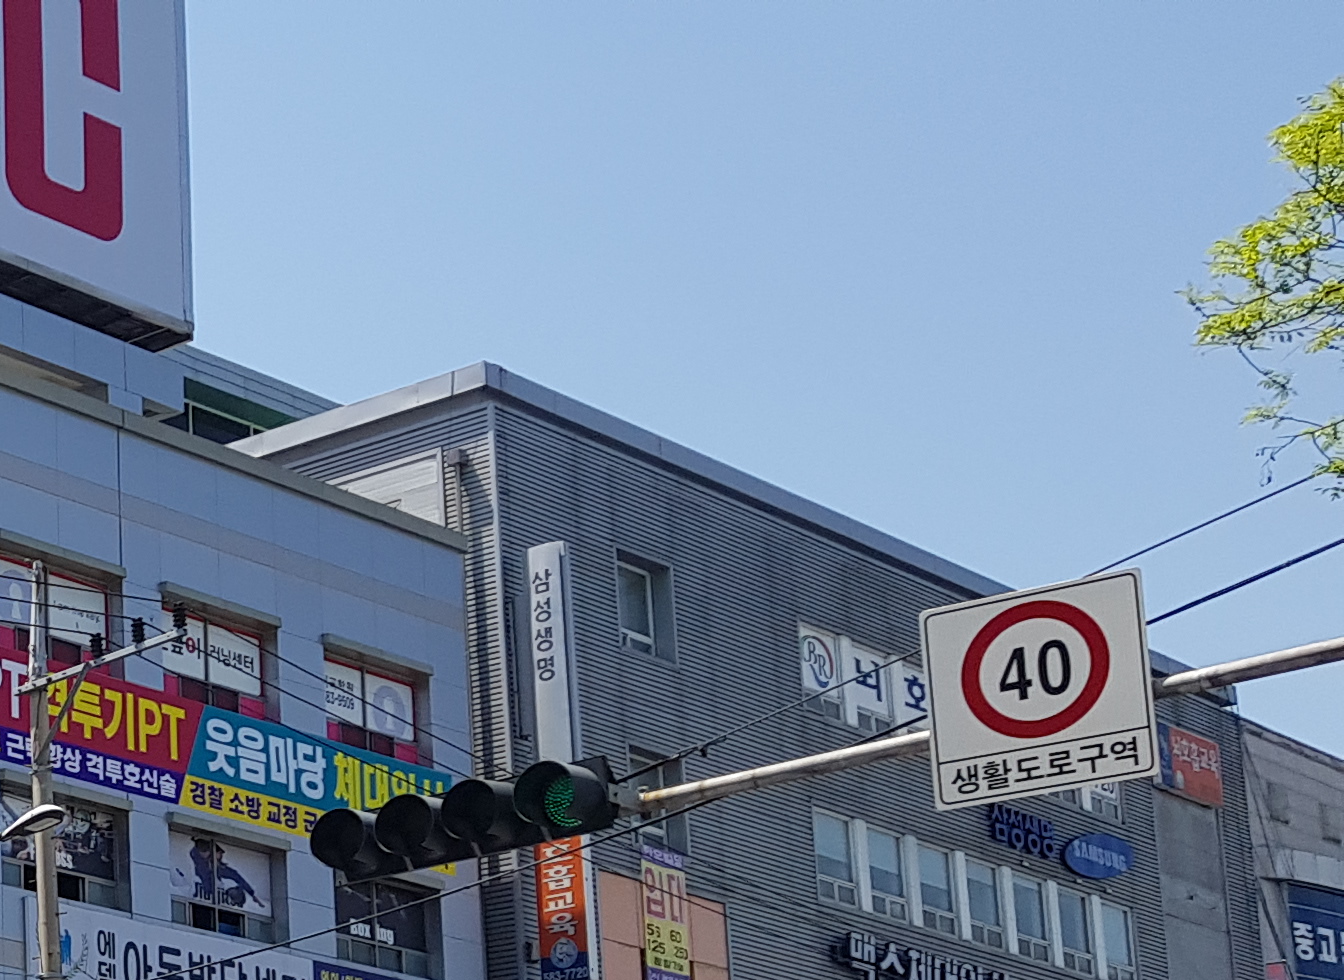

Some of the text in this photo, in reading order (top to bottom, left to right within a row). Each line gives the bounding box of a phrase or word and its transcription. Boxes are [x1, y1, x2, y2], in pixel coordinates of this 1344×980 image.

[531, 568, 556, 683] 삼성생명
[999, 639, 1072, 702] 40
[86, 754, 178, 799] 격투호신술
[205, 717, 328, 800] 웃음마당
[951, 736, 1141, 795] 생활도로구역
[189, 780, 224, 814] 경찰
[229, 790, 261, 824] 소방
[266, 800, 298, 833] 교정
[1072, 839, 1128, 872] SAMSUNG
[1292, 920, 1344, 964] 중고
